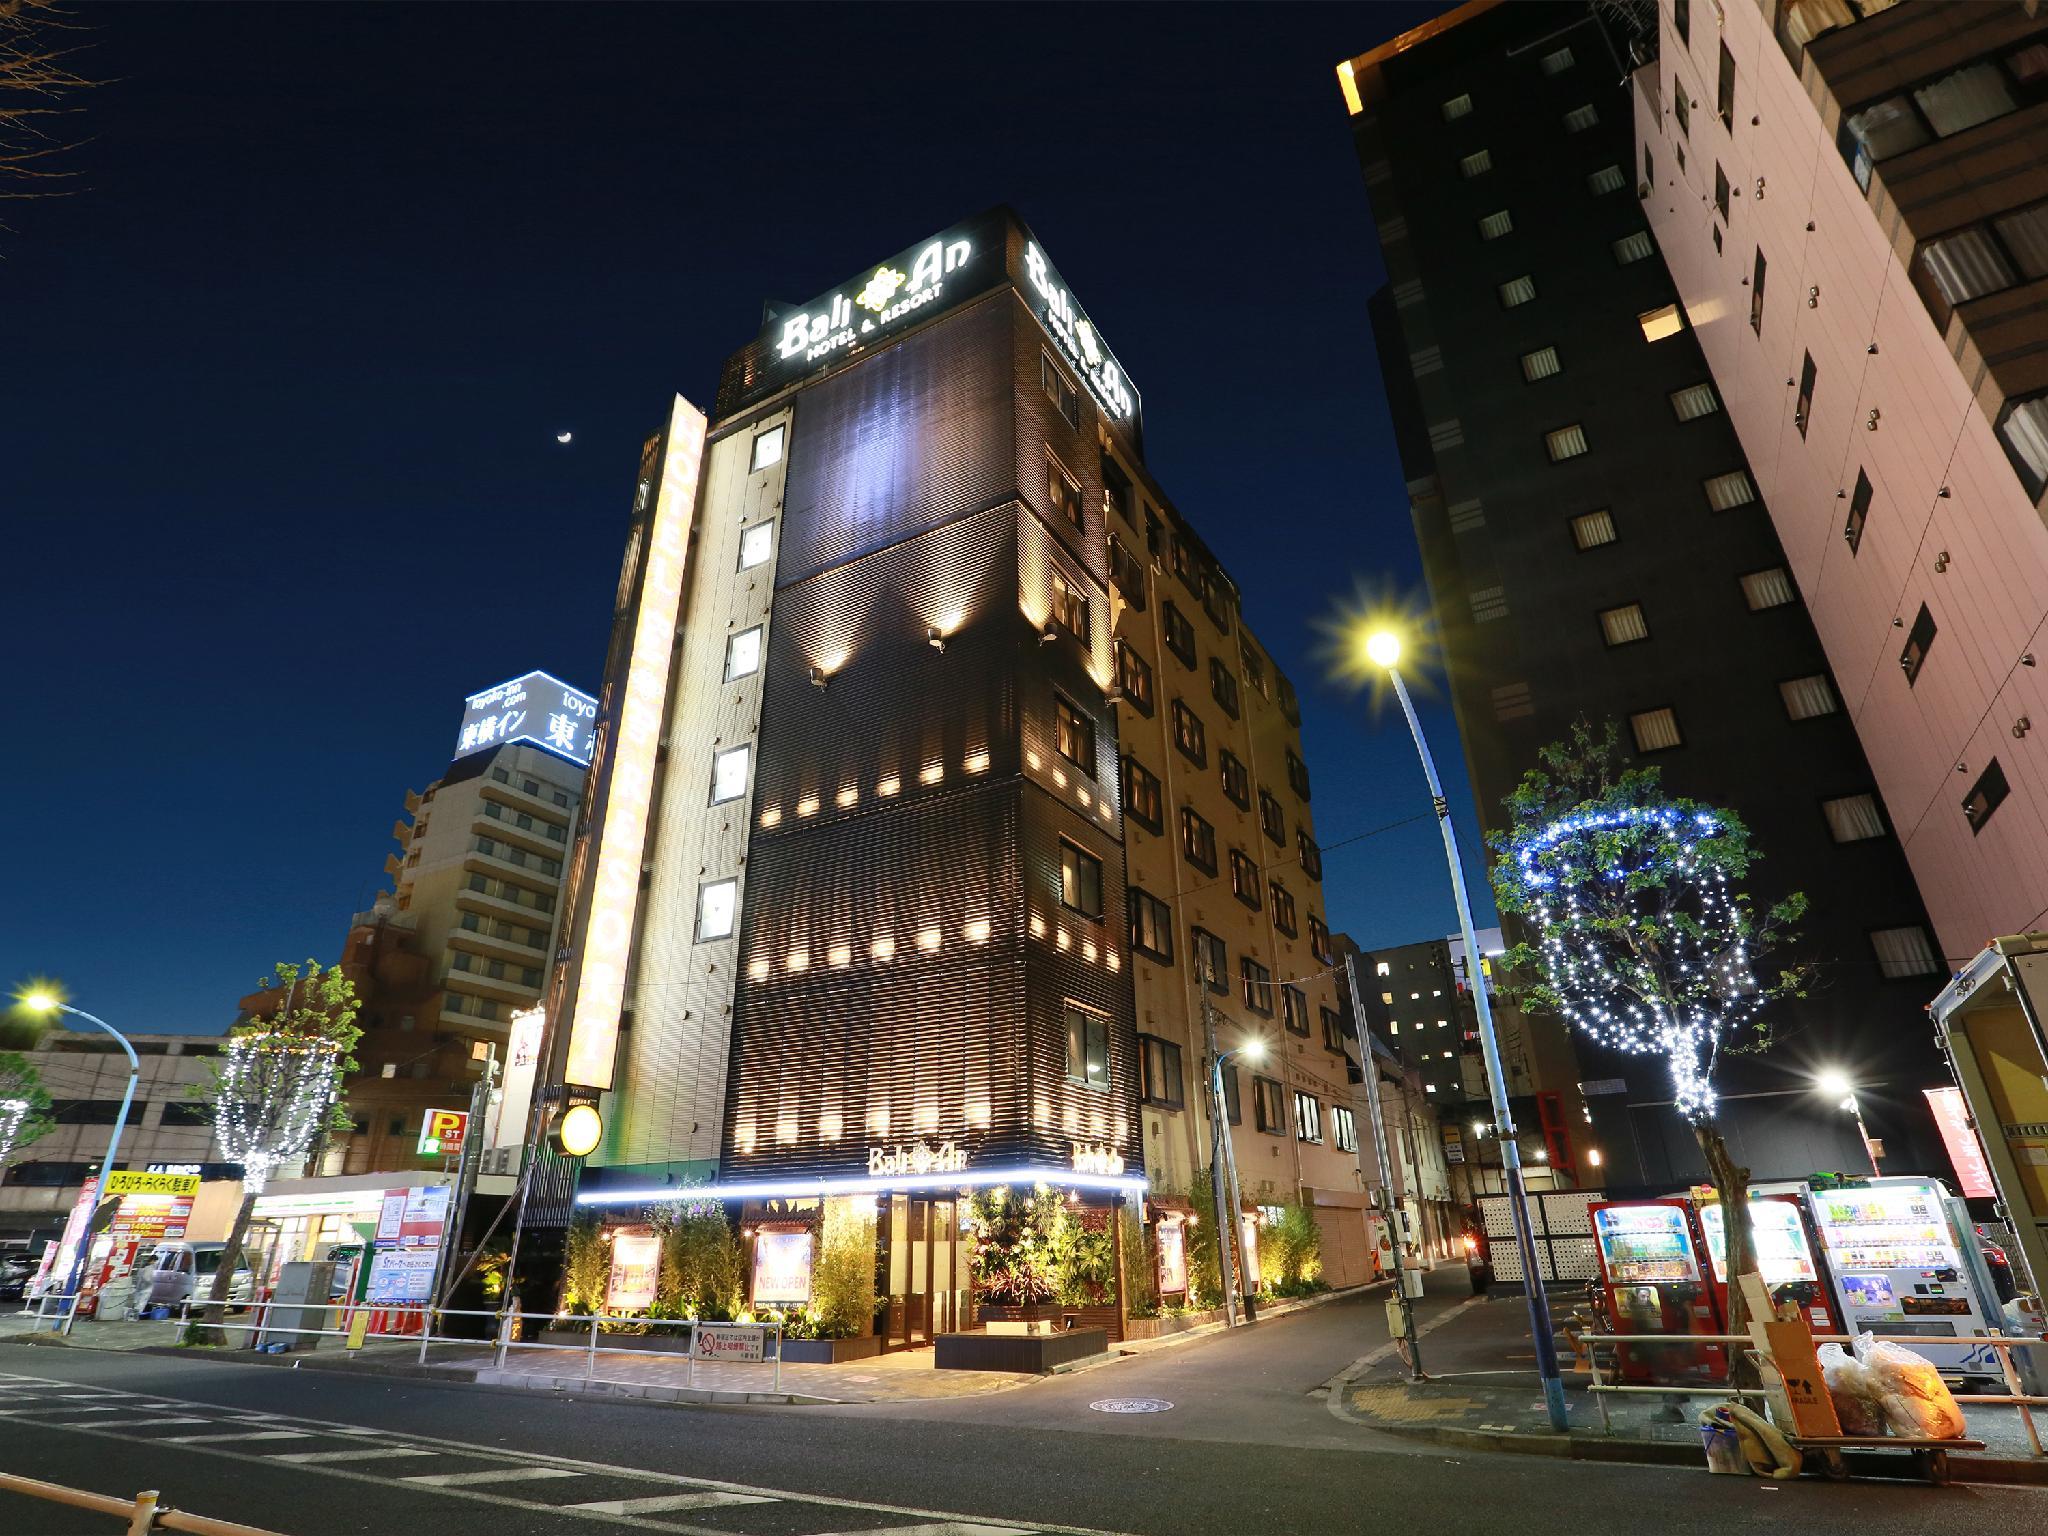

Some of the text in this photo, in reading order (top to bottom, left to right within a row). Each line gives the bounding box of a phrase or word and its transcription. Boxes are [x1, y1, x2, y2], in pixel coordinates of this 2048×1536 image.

[776, 240, 971, 359] Bali An
[807, 283, 943, 361] HOTEL & RESORT
[1025, 241, 1131, 416] Bali An
[472, 683, 522, 710] toyoko-inn
[459, 710, 527, 751] 東横イン
[433, 1113, 460, 1137] P
[445, 1130, 460, 1139] ST
[866, 1146, 907, 1175] Bali
[781, 1276, 807, 1289] OPEN
